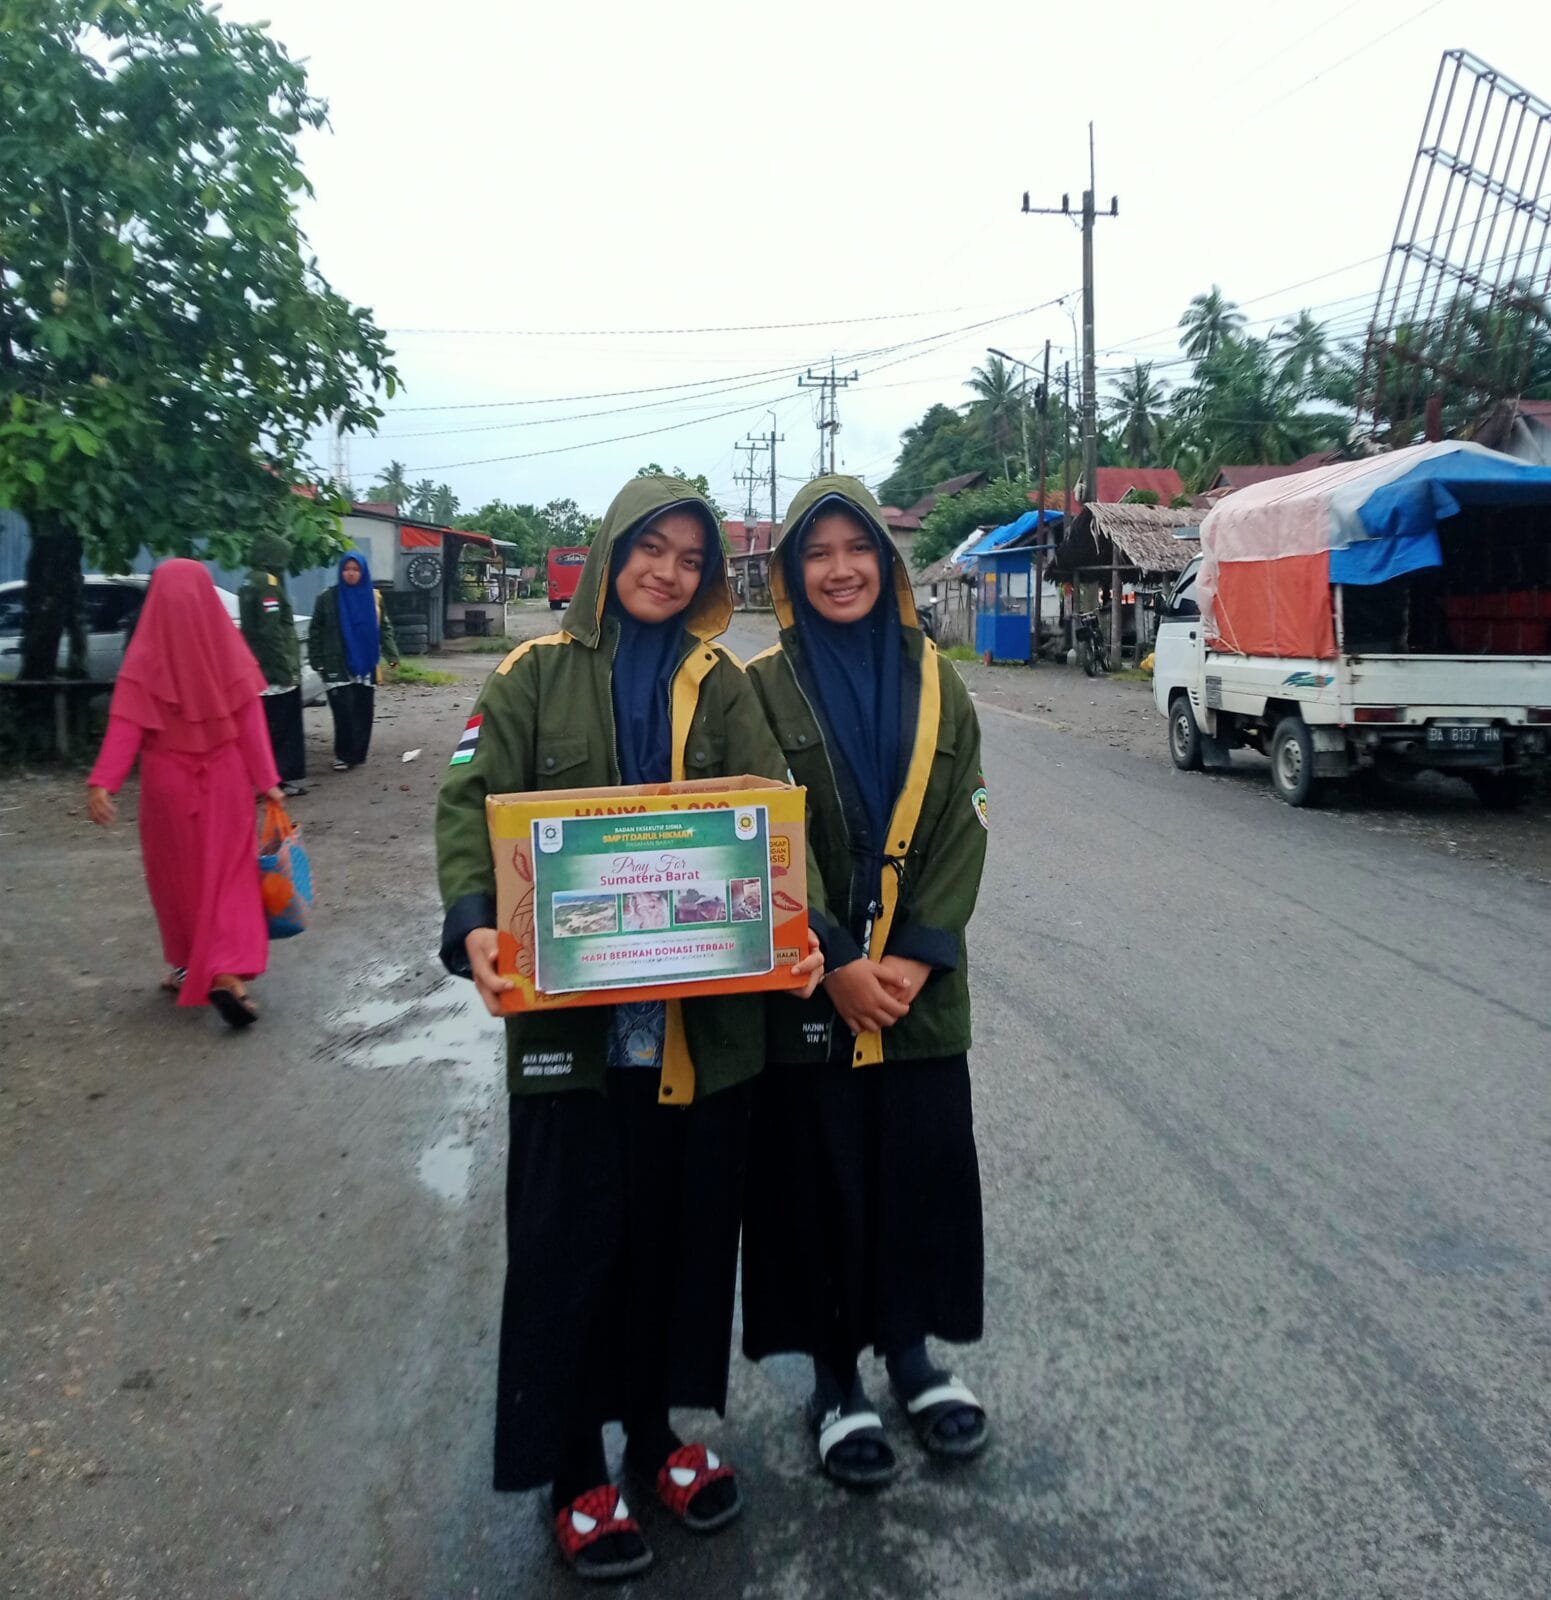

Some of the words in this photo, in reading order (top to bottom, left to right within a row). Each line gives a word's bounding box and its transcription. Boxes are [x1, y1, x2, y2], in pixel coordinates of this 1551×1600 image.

[1430, 728, 1444, 741] BA
[1452, 728, 1478, 741] 8137
[1484, 728, 1500, 741] HN
[630, 832, 657, 841] DARUL
[612, 856, 649, 876] Pray
[655, 854, 686, 872] For
[600, 874, 662, 886] Sumatera
[666, 870, 700, 881] Barat
[581, 952, 607, 962] MARI
[610, 948, 652, 960] BERIKAN
[655, 945, 692, 956] DONASI
[695, 942, 735, 952] TERBAIK
[776, 951, 798, 959] HALAL
